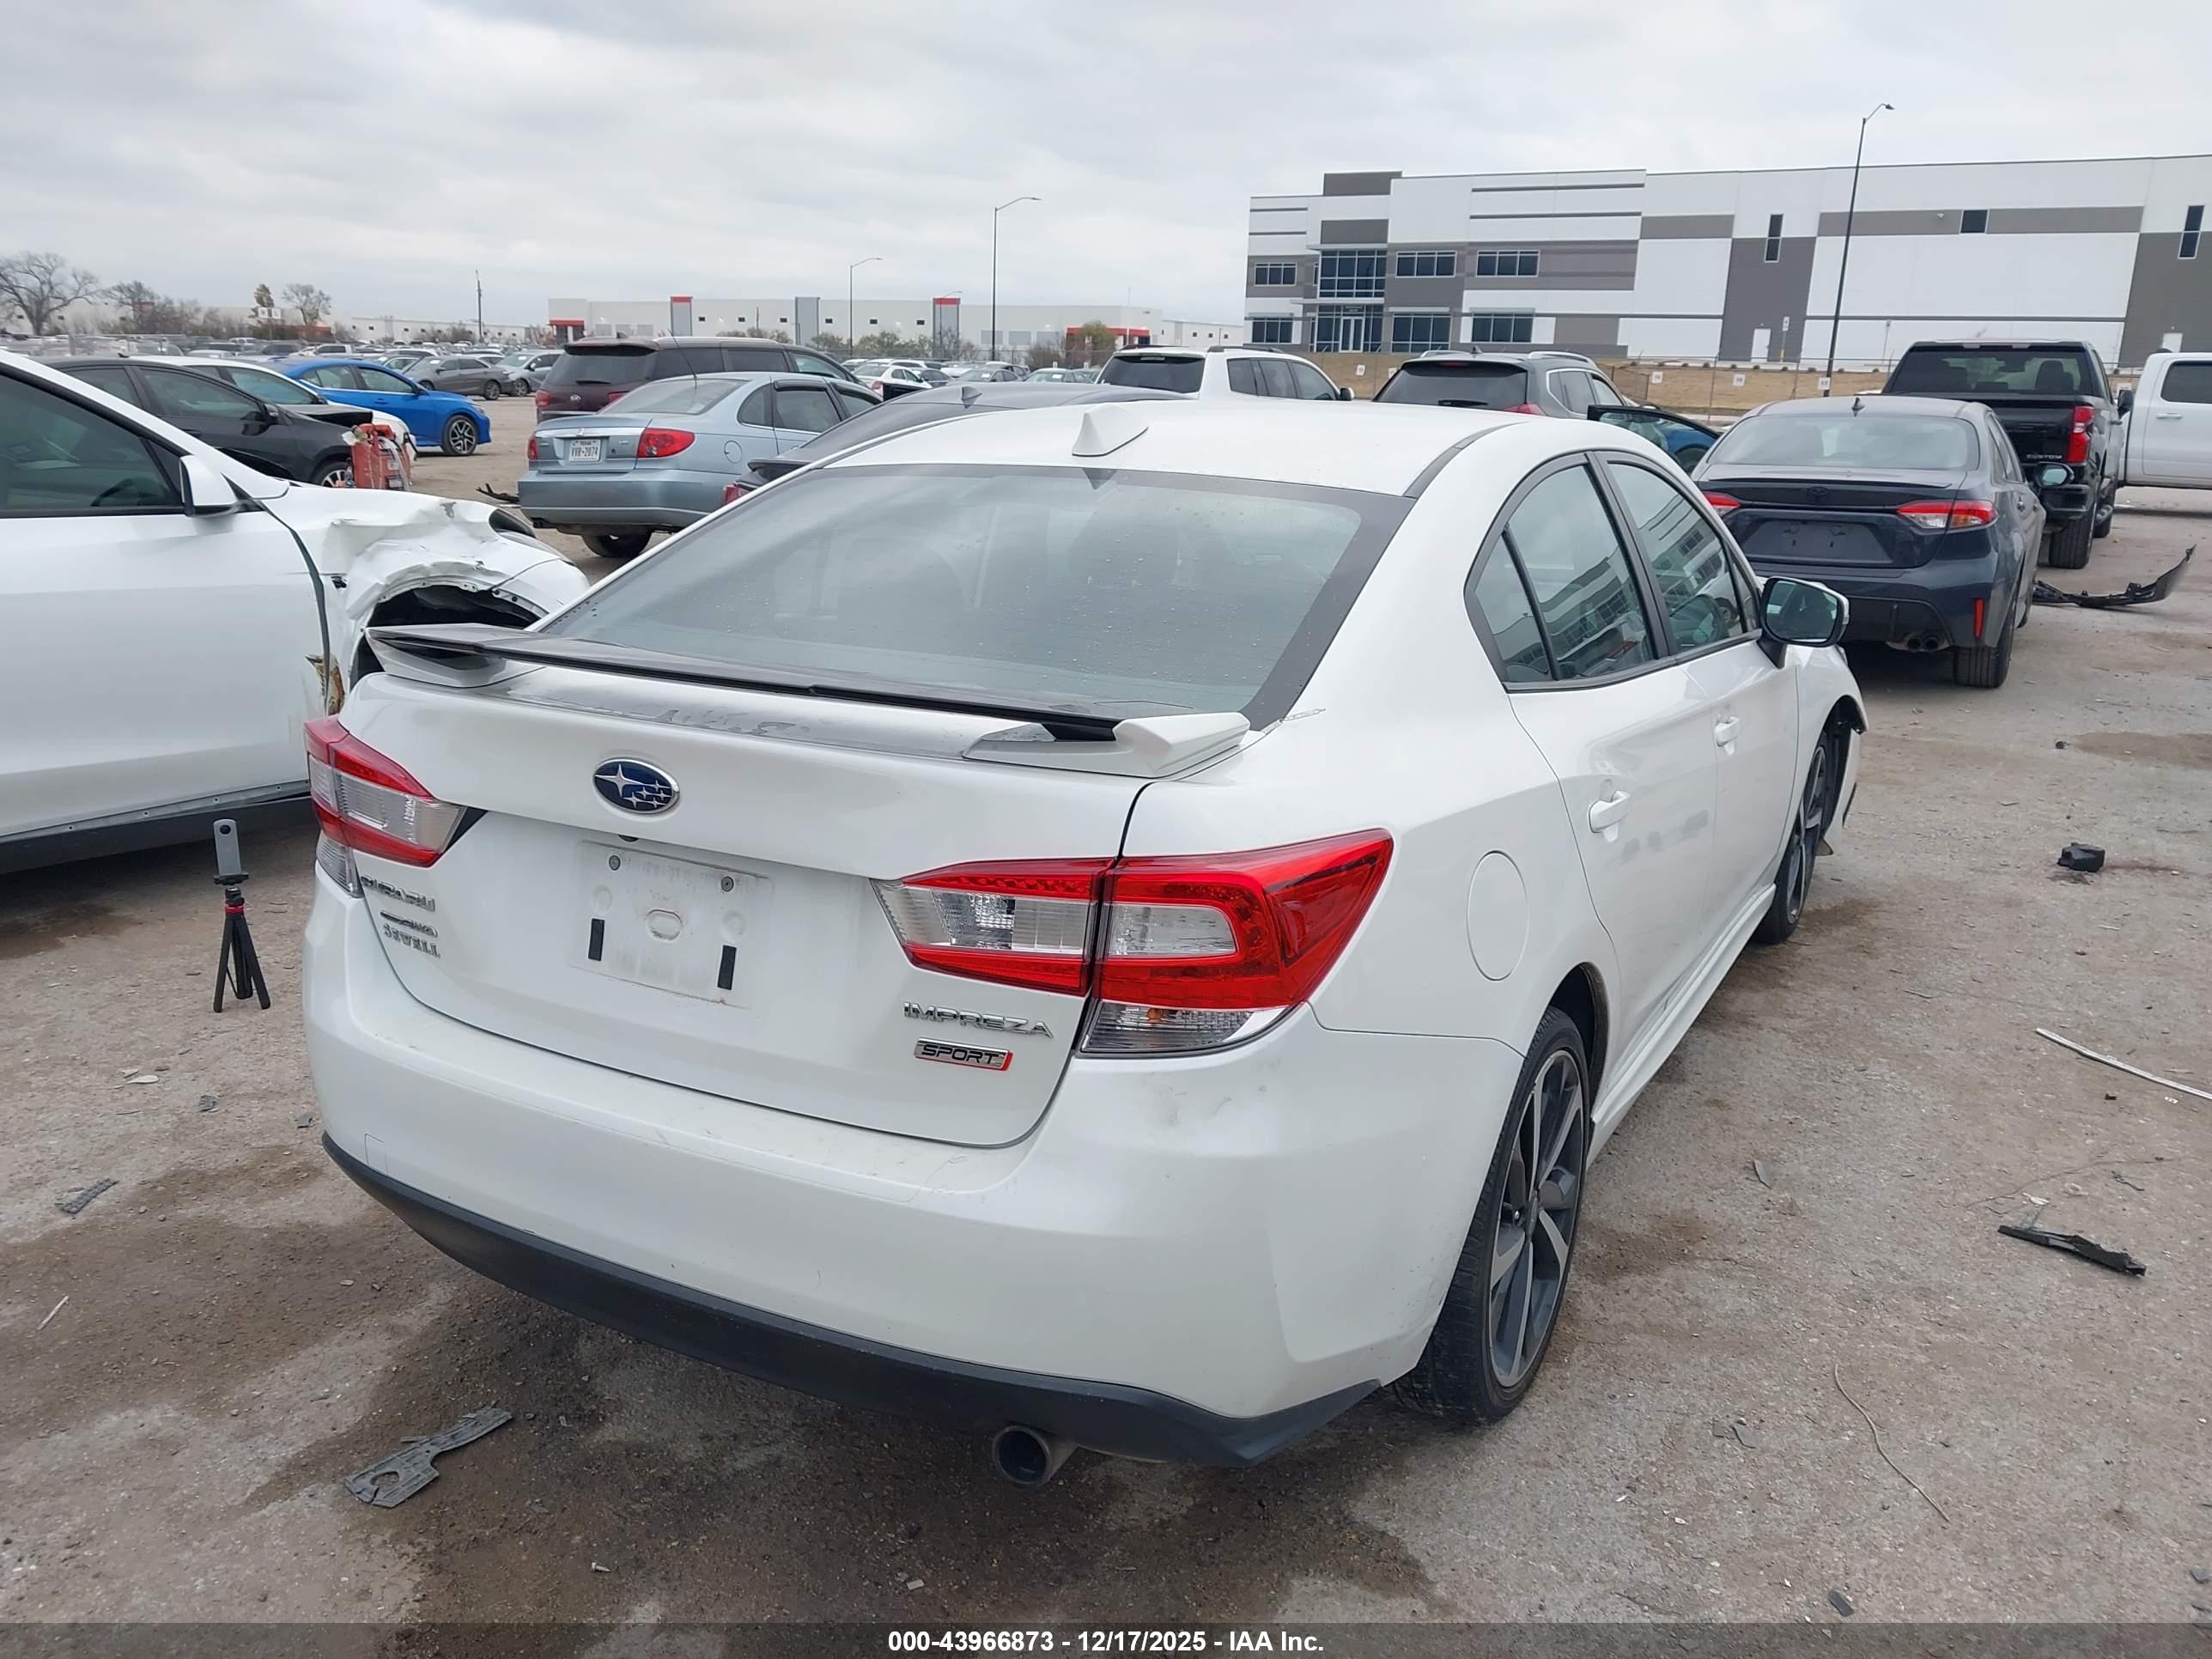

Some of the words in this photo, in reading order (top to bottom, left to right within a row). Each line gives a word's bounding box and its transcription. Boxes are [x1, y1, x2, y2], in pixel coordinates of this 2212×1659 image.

[383, 922, 441, 958] SEWELL
[902, 1001, 1054, 1038] IMPREZA
[921, 1043, 999, 1065] SPORT
